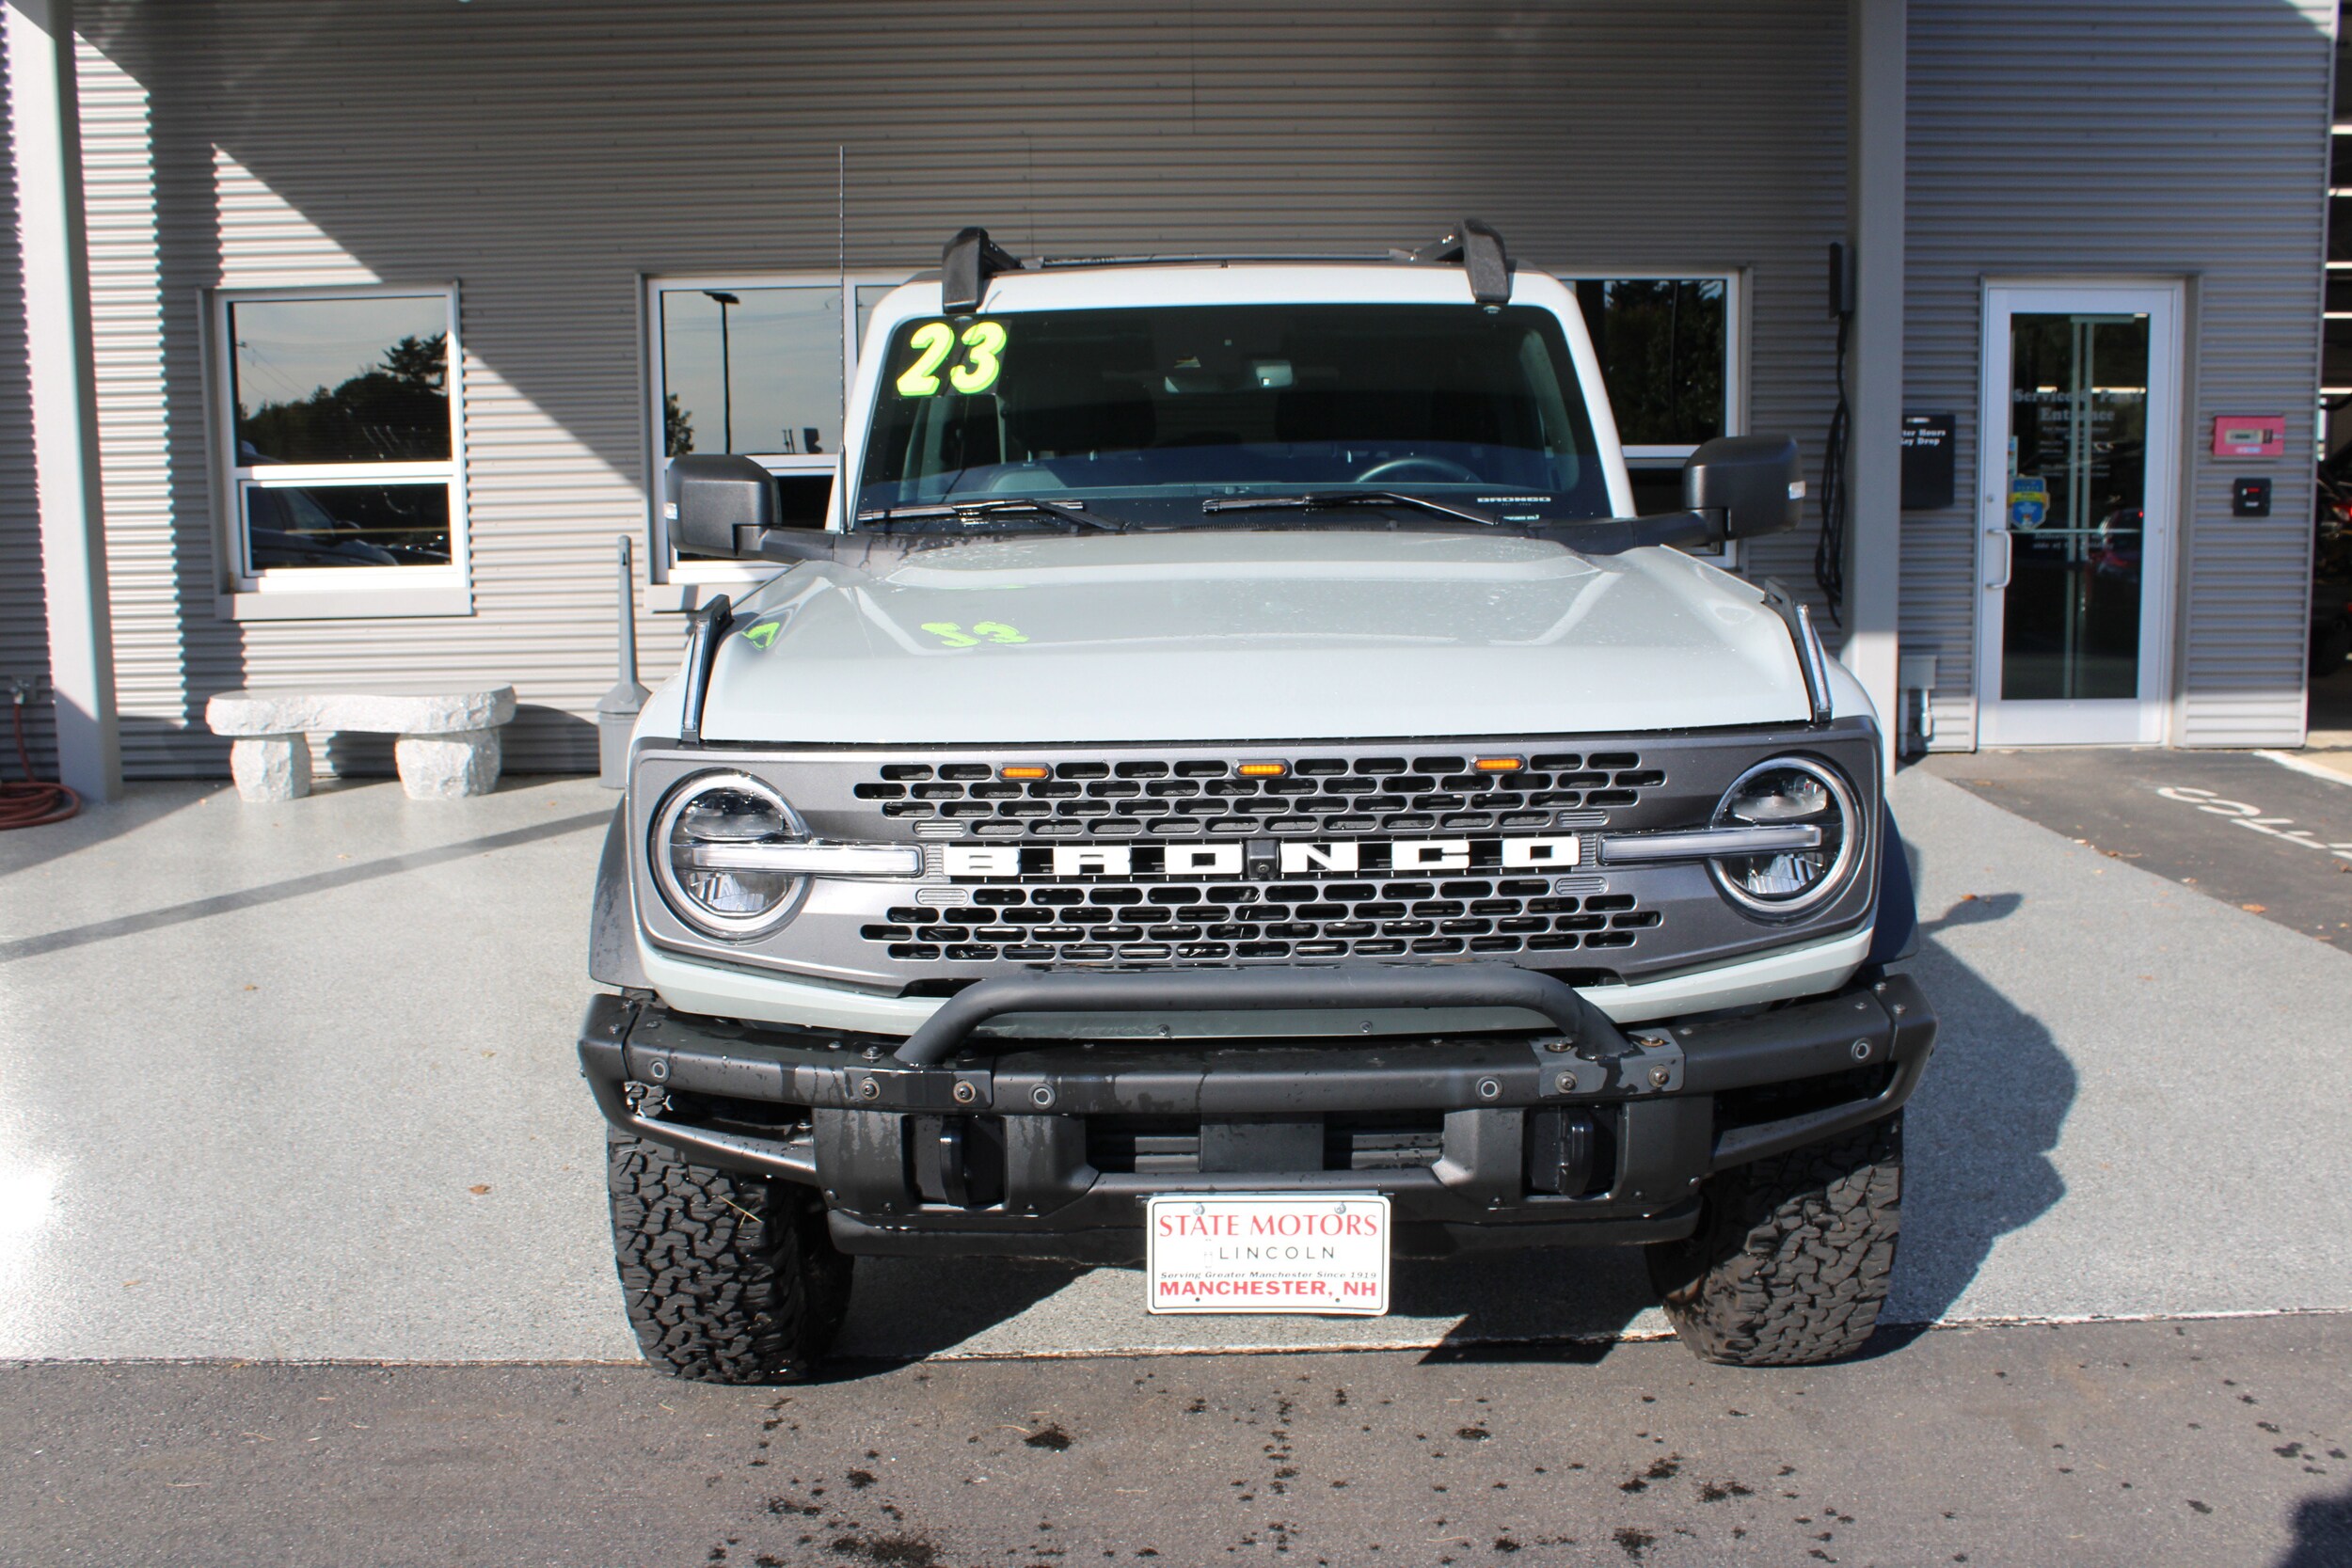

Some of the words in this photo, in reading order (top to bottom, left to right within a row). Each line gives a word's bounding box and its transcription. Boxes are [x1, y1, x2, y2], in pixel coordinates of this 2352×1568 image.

[897, 322, 1007, 396] 23
[943, 836, 1580, 876] BRONCO
[1159, 1214, 1239, 1237] STATE
[1250, 1214, 1377, 1237] MOTORS
[1219, 1246, 1334, 1259] LINCOLN
[1160, 1280, 1333, 1297] MANCHESTER,
[1343, 1281, 1376, 1296] NH
